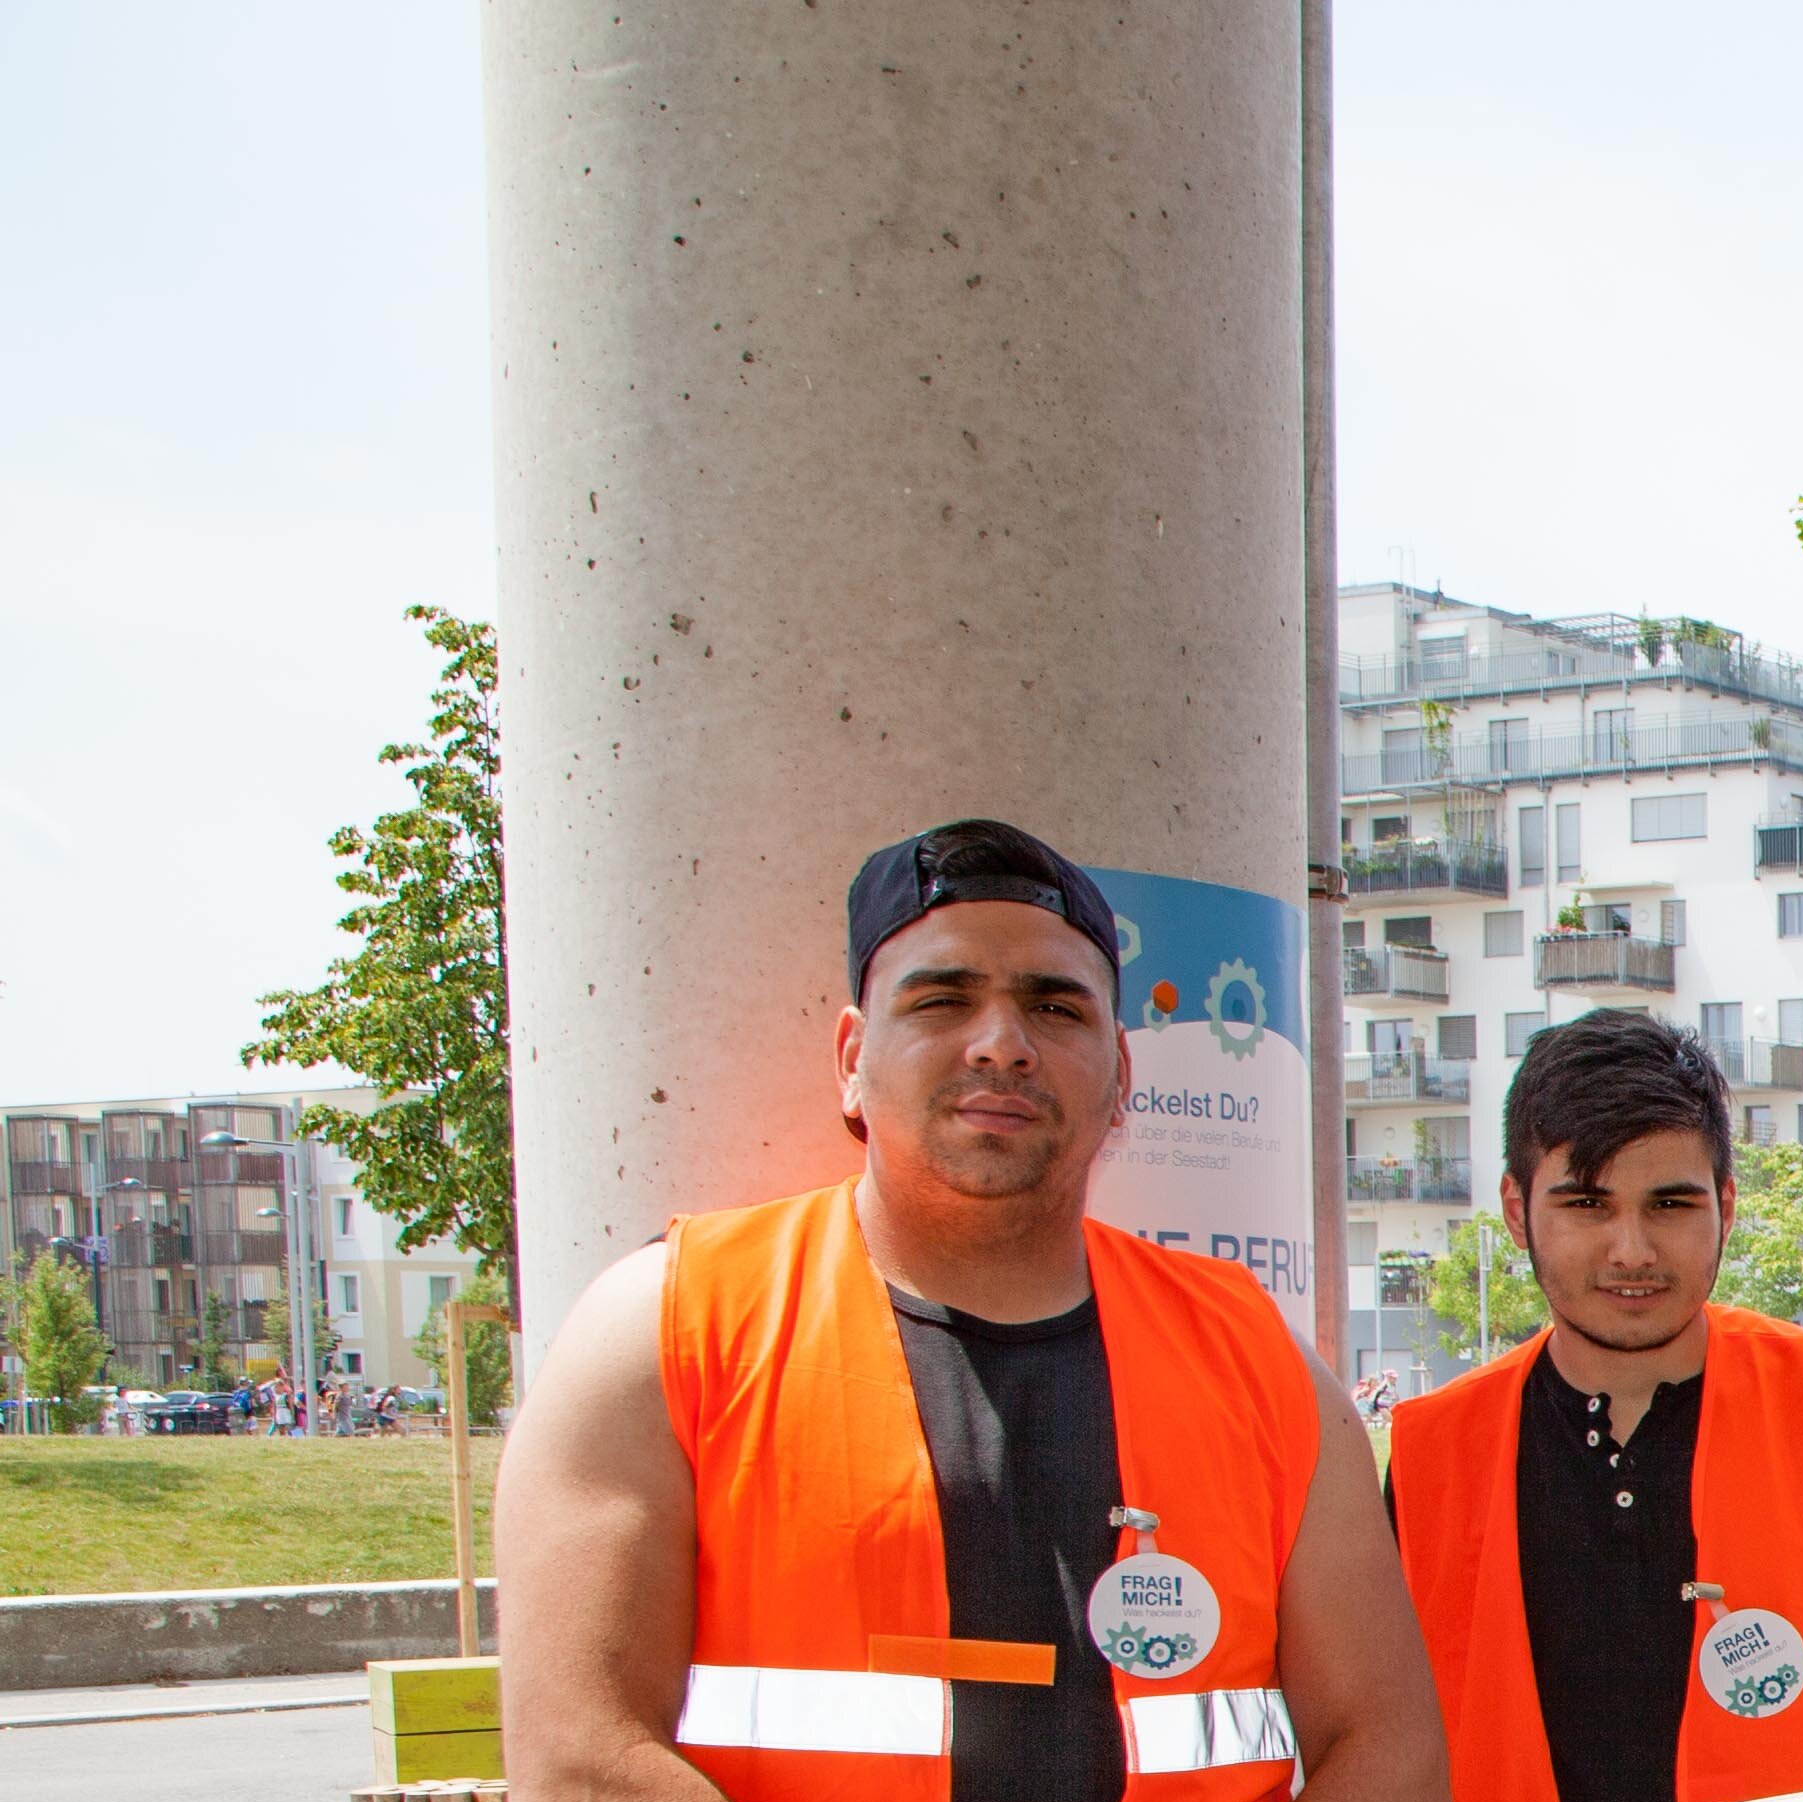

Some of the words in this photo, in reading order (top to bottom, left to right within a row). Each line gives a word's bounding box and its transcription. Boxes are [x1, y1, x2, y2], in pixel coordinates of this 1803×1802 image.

[1124, 1086, 1213, 1119] ckelst
[1220, 1092, 1260, 1124] Du?
[1135, 1123, 1168, 1142] über
[1171, 1127, 1193, 1143] die
[1194, 1130, 1228, 1147] vielen
[1231, 1131, 1265, 1150] Berufe
[1127, 1151, 1140, 1163] in
[1144, 1151, 1169, 1165] der
[1172, 1150, 1232, 1171] Seestadt!
[1121, 1575, 1172, 1590] FRAG
[1714, 1627, 1755, 1655] FRAG
